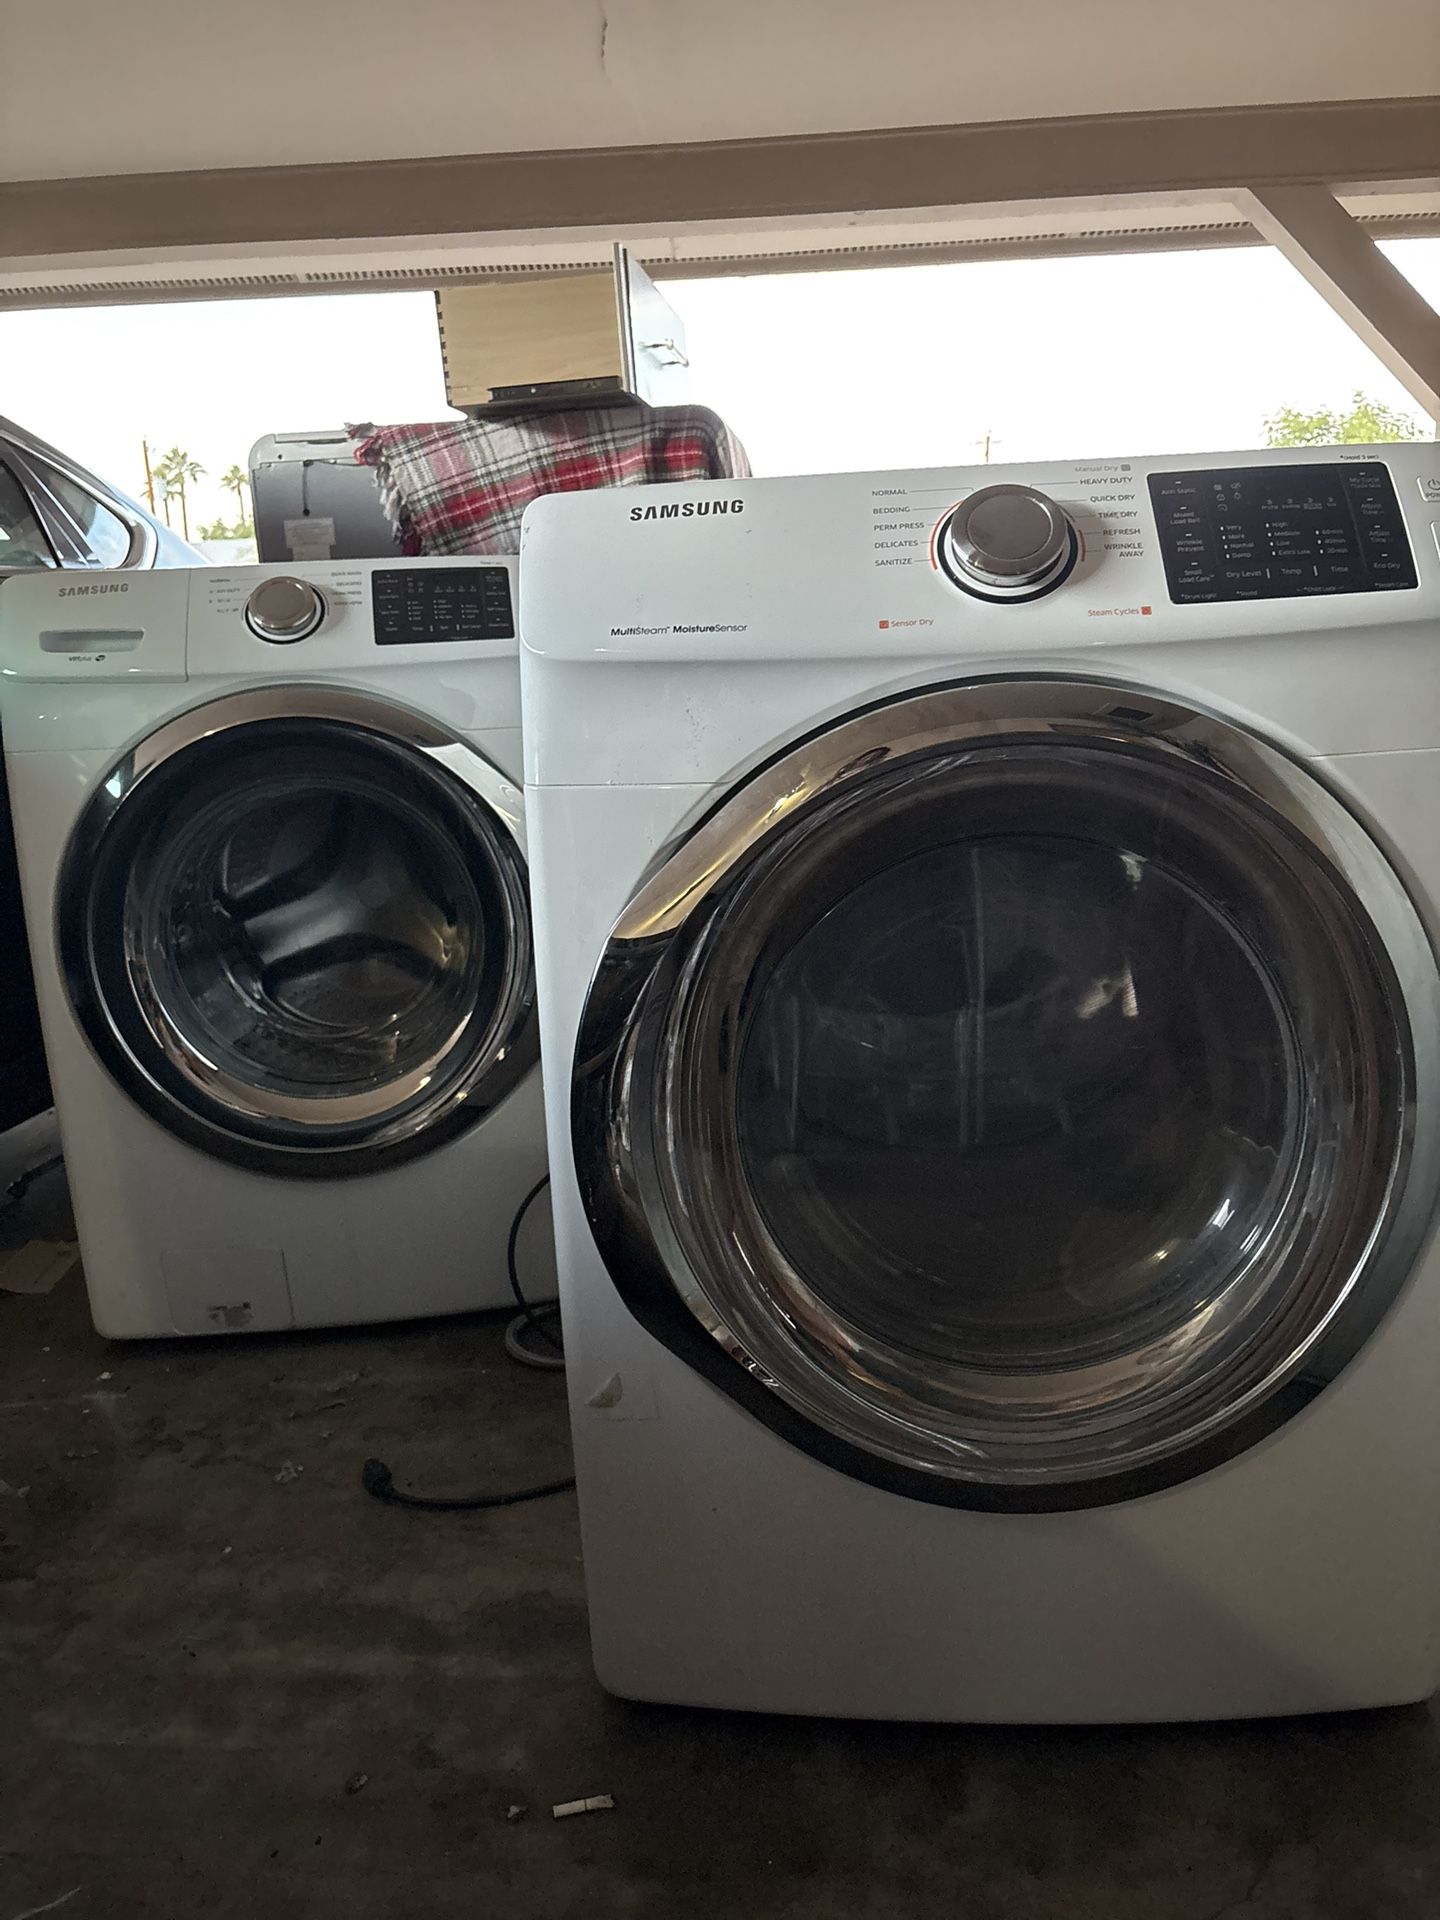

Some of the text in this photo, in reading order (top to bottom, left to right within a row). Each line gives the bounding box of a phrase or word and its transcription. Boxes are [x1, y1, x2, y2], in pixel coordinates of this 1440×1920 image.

[872, 489, 908, 497] NORMAL
[1090, 495, 1116, 503] QUICK
[630, 499, 744, 521] SAMSUNG
[873, 506, 911, 515] BEDDING
[873, 522, 925, 531] PERM PRESS
[1103, 528, 1141, 536] REFRESH
[874, 540, 919, 549] DELICATES
[875, 558, 913, 567] SANITIZE
[58, 583, 129, 598] SAMSUNG
[1087, 607, 1140, 617] Steam Cycles
[891, 618, 935, 628] Sensor Dry
[672, 624, 748, 634] MoistureSensor
